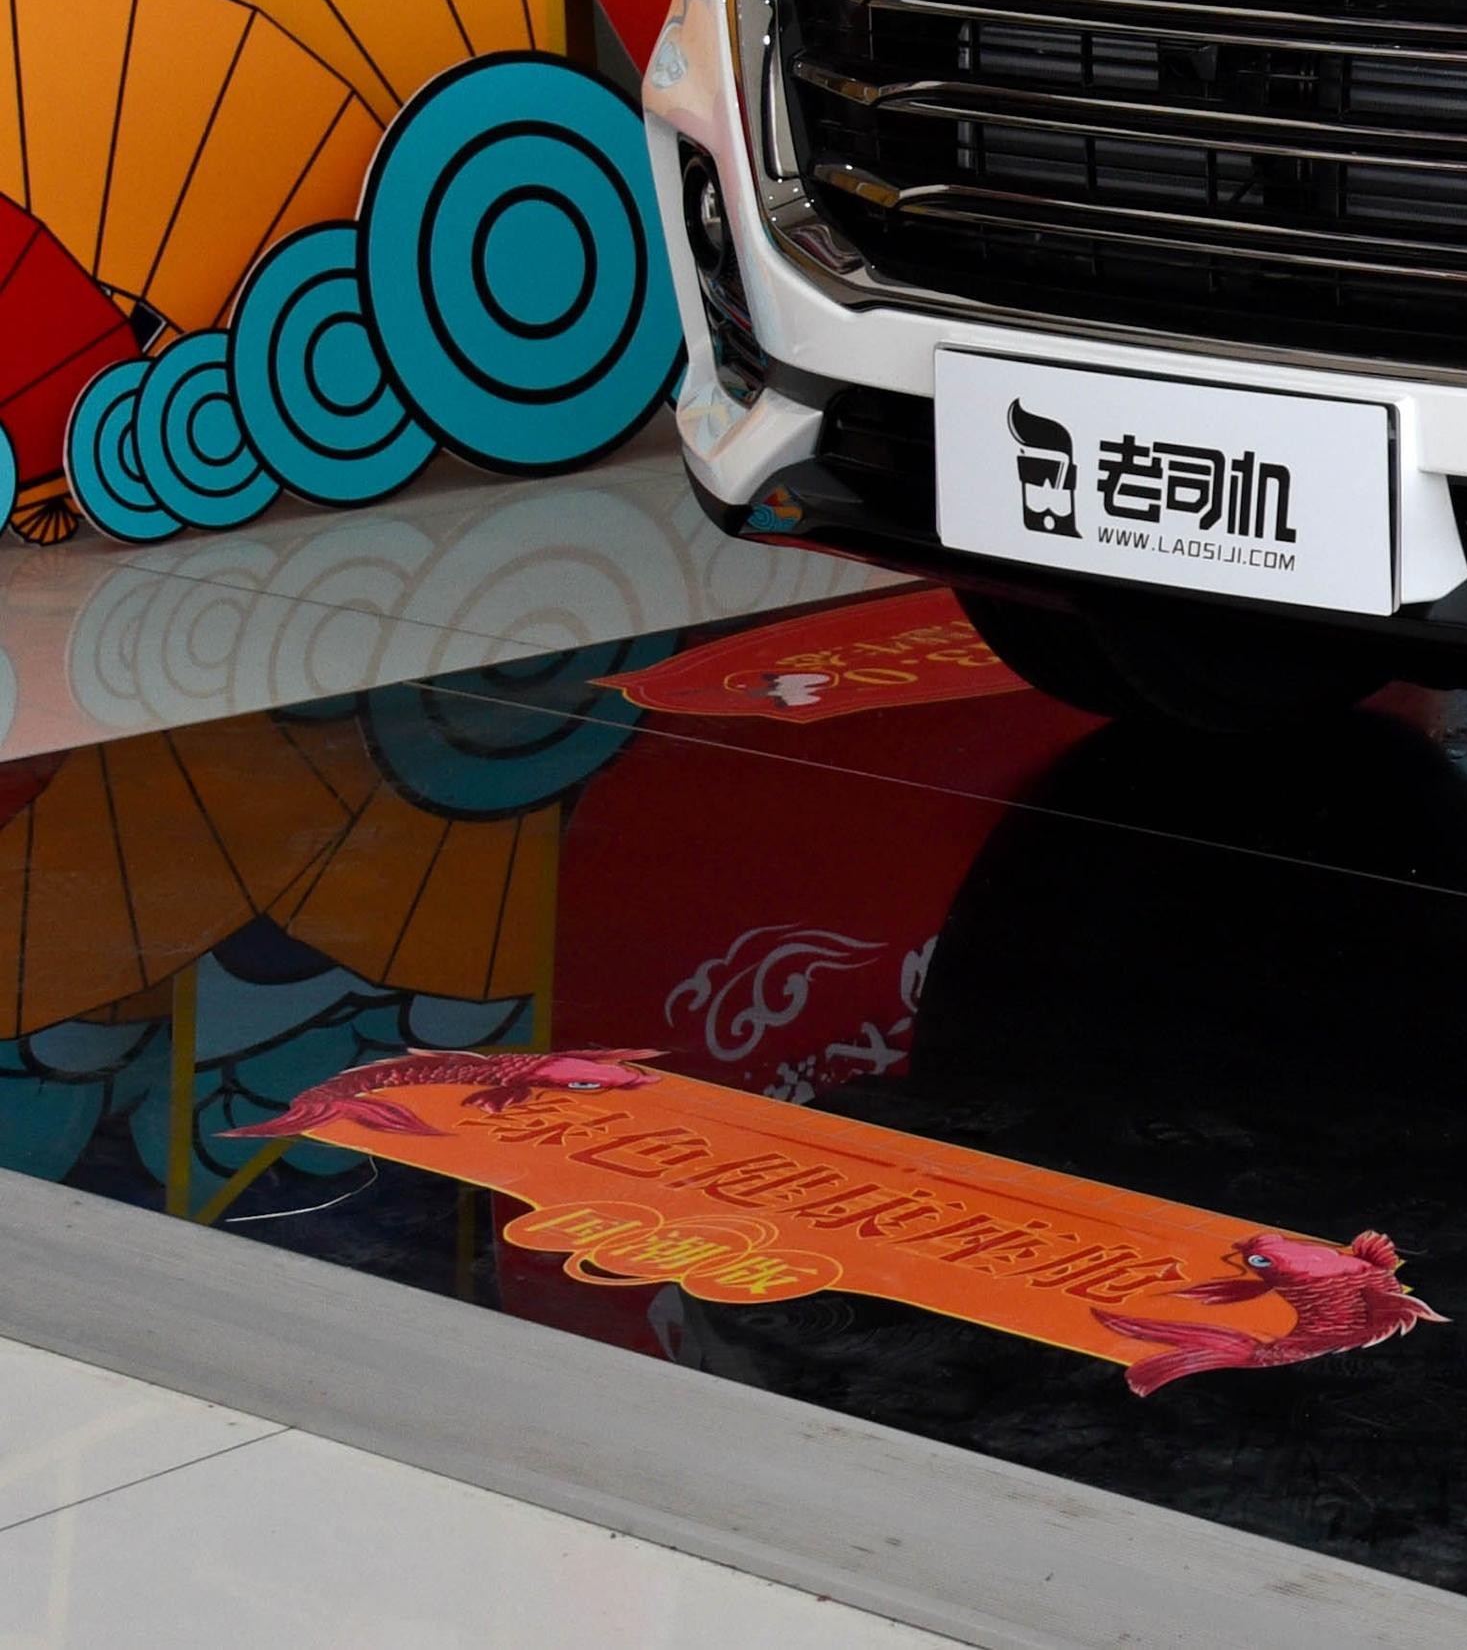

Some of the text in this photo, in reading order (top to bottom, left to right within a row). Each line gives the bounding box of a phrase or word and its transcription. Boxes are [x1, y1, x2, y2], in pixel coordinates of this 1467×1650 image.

[1097, 433, 1297, 544] 老司机
[1097, 525, 1296, 571] WWW.LAOSIJI.COM
[455, 1096, 1191, 1304] 绿色健康座舱
[524, 1207, 818, 1295] 国潮版
